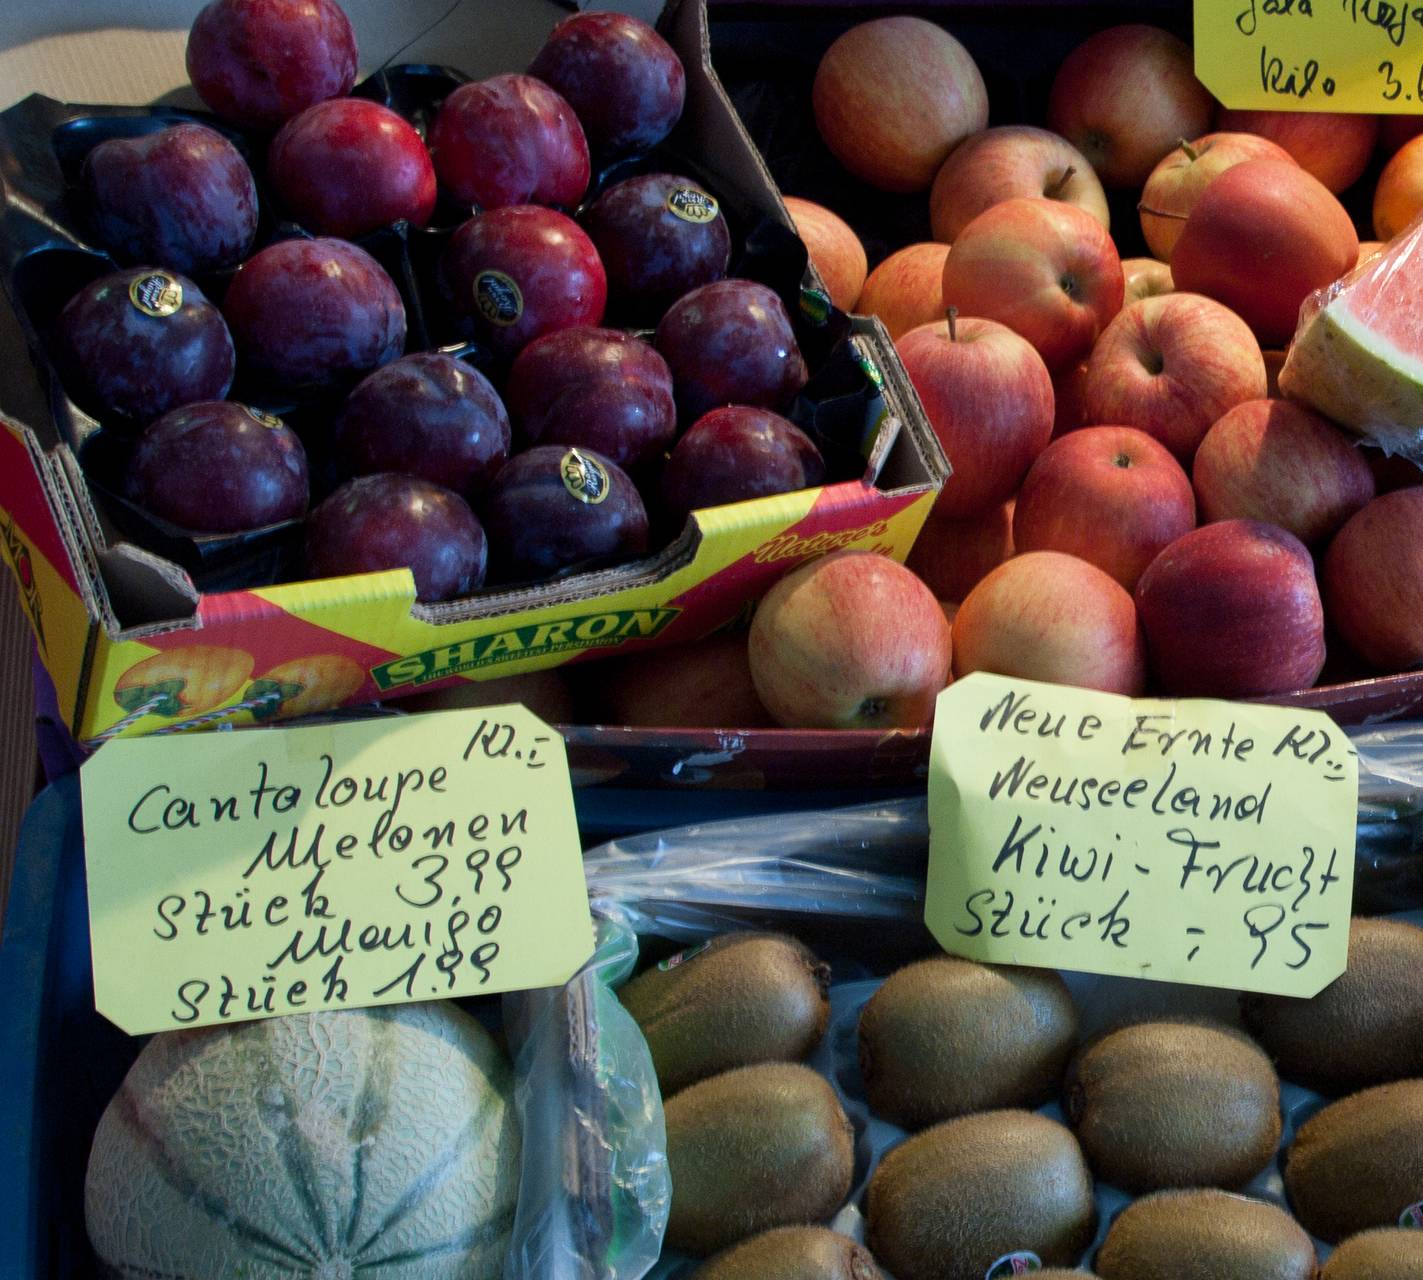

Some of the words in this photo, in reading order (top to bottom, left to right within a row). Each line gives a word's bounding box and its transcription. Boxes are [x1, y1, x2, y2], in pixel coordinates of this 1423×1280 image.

[387, 607, 676, 684] SHARON
[979, 691, 1101, 740] Neue
[1122, 715, 1254, 761] Ernte
[128, 755, 447, 834] Cantaloupe
[989, 756, 1271, 824] Neuseeland
[243, 809, 528, 878] Melonen
[153, 870, 335, 940] Stück
[267, 905, 501, 969] Mango
[954, 890, 1130, 948] Stück
[172, 956, 348, 1024] Stück
